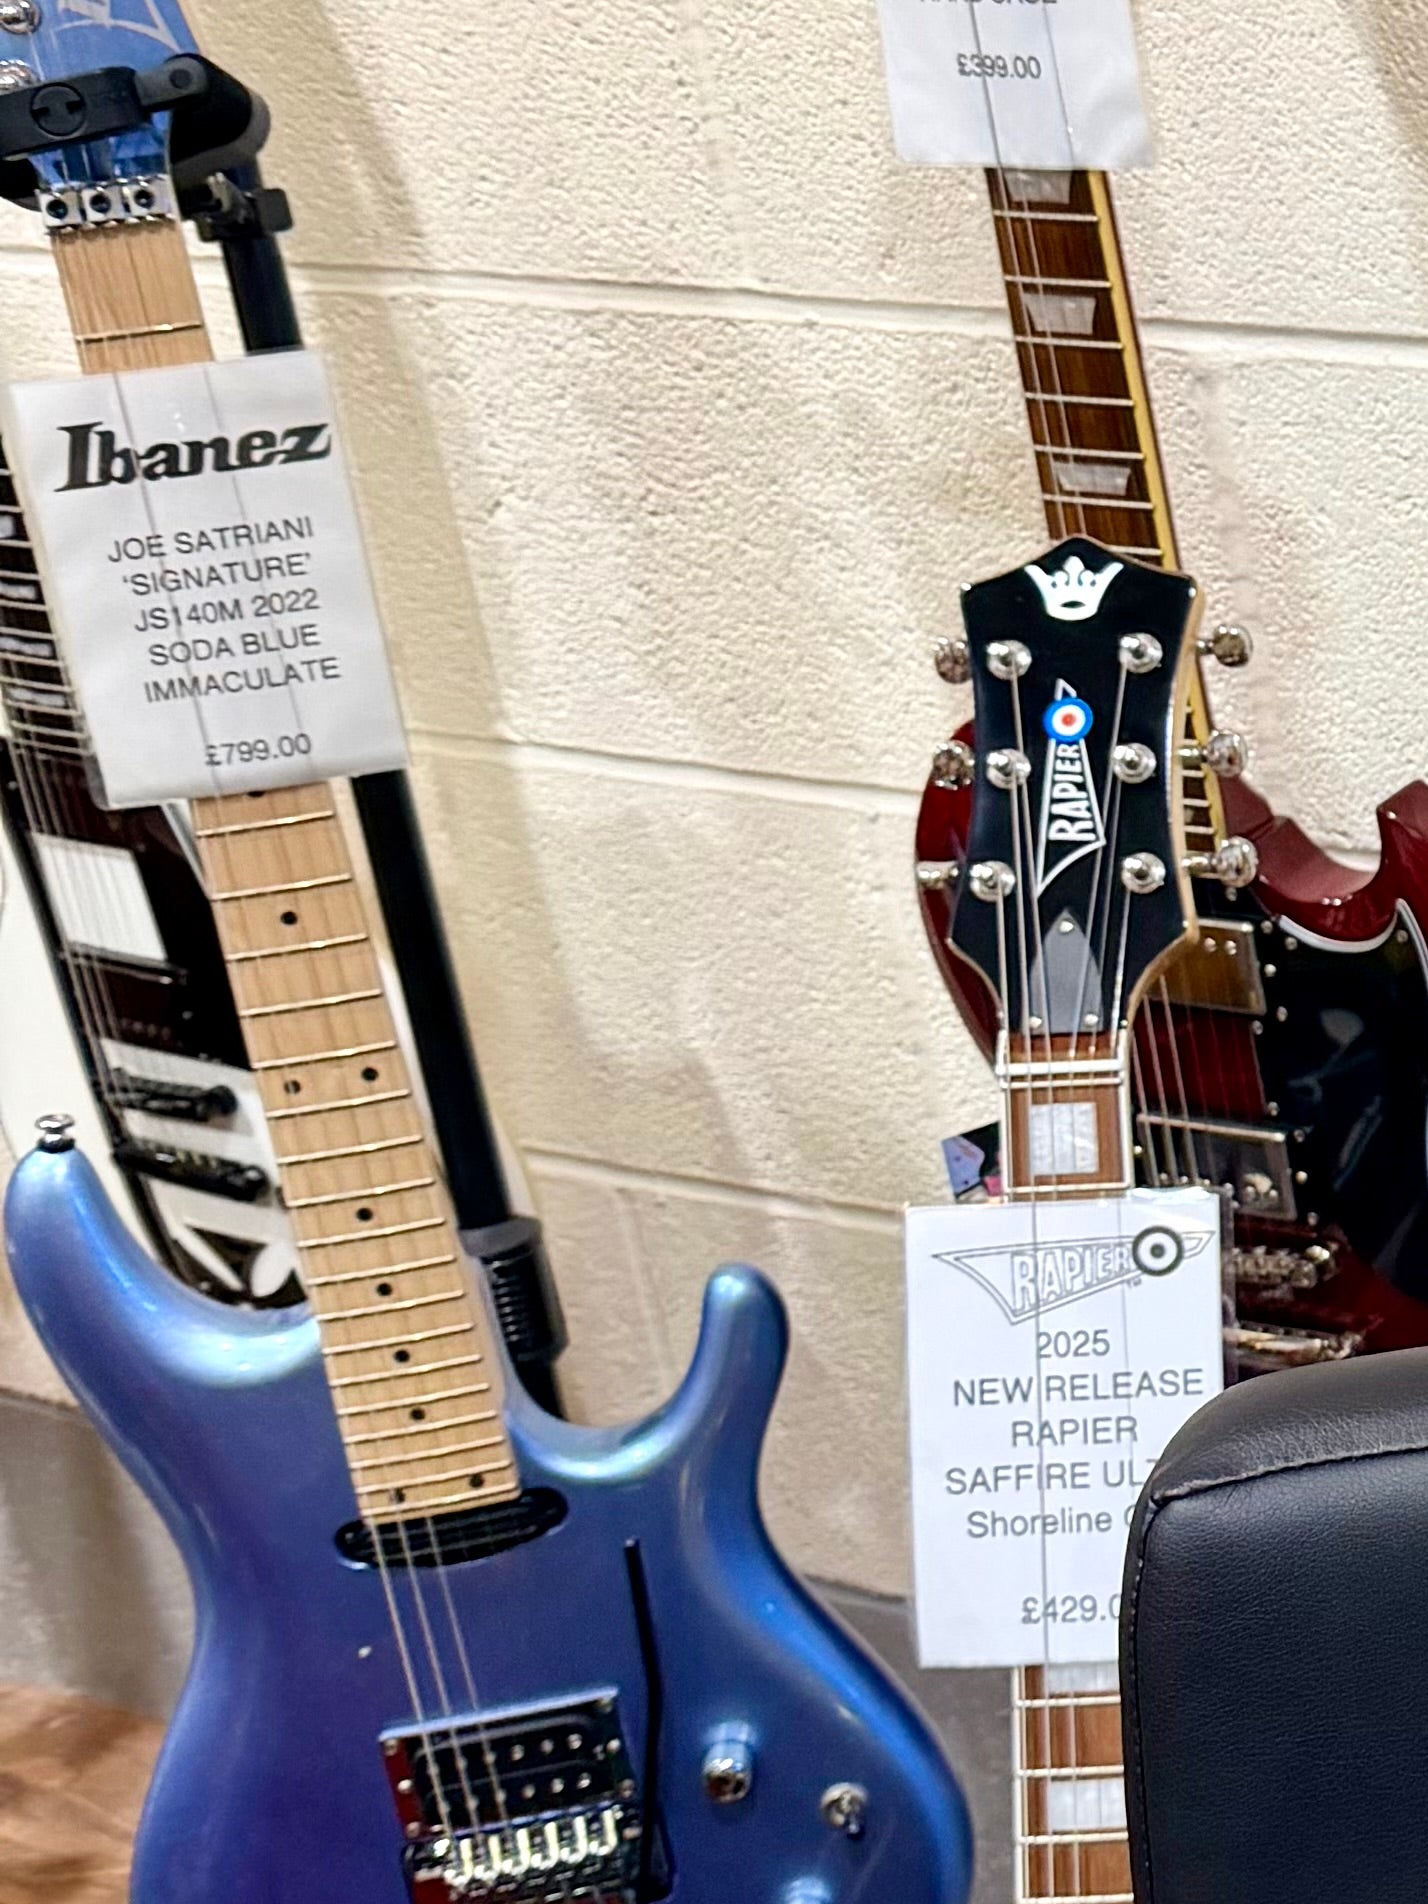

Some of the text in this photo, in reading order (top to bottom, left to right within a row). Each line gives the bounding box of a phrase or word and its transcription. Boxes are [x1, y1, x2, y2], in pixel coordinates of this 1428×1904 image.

[956, 53, 1042, 79] £399.00
[54, 421, 332, 492] Ibanez
[107, 516, 315, 564] JOE SATRIANI
[134, 587, 321, 633] JS140M 2022
[148, 623, 322, 666] SODA BLUE
[143, 656, 343, 704] IMMACULATE
[204, 732, 312, 766] £799.00
[1047, 743, 1097, 841] RAPIER
[1011, 1243, 1131, 1313] RAPIER
[1037, 1328, 1111, 1359] 2025
[953, 1367, 1204, 1407] NEW RELEASE
[1011, 1415, 1139, 1447] RAPIER
[945, 1460, 1091, 1496] SAFFIRE
[966, 1507, 1113, 1539] Shoreline
